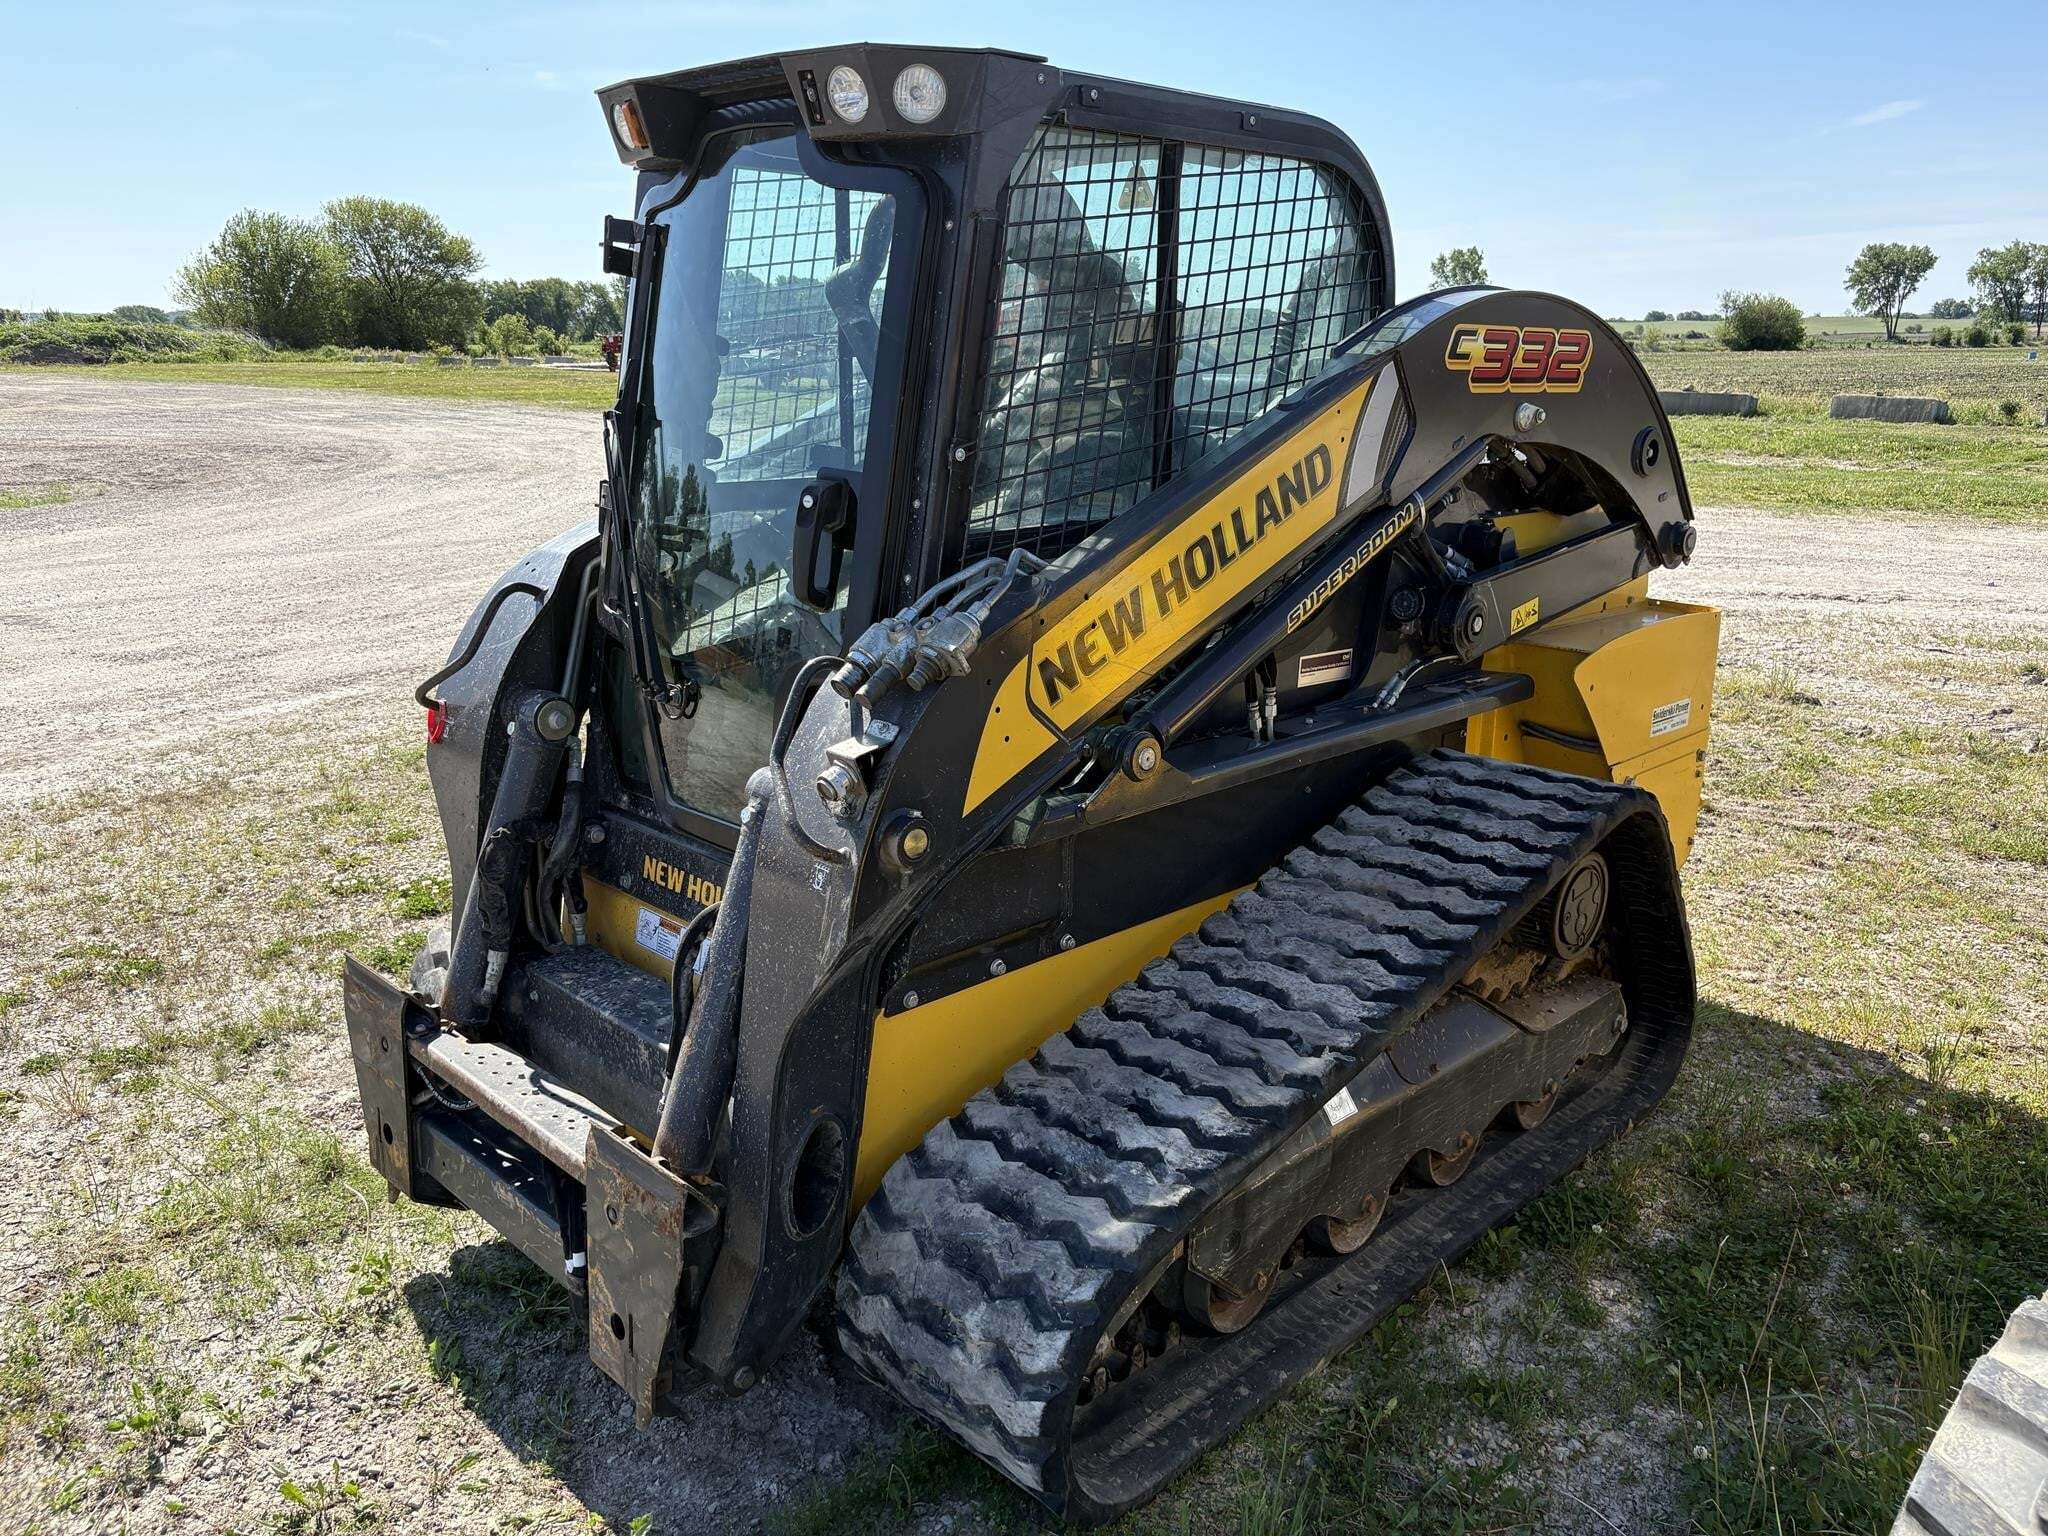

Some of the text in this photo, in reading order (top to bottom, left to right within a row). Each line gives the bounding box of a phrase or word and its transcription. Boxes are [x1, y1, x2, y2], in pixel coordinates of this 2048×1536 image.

[1446, 324, 1593, 393] C332
[1037, 443, 1334, 708] NEW HOLLAND
[1287, 502, 1415, 634] SUPER BOOM
[643, 855, 685, 893] NEW
